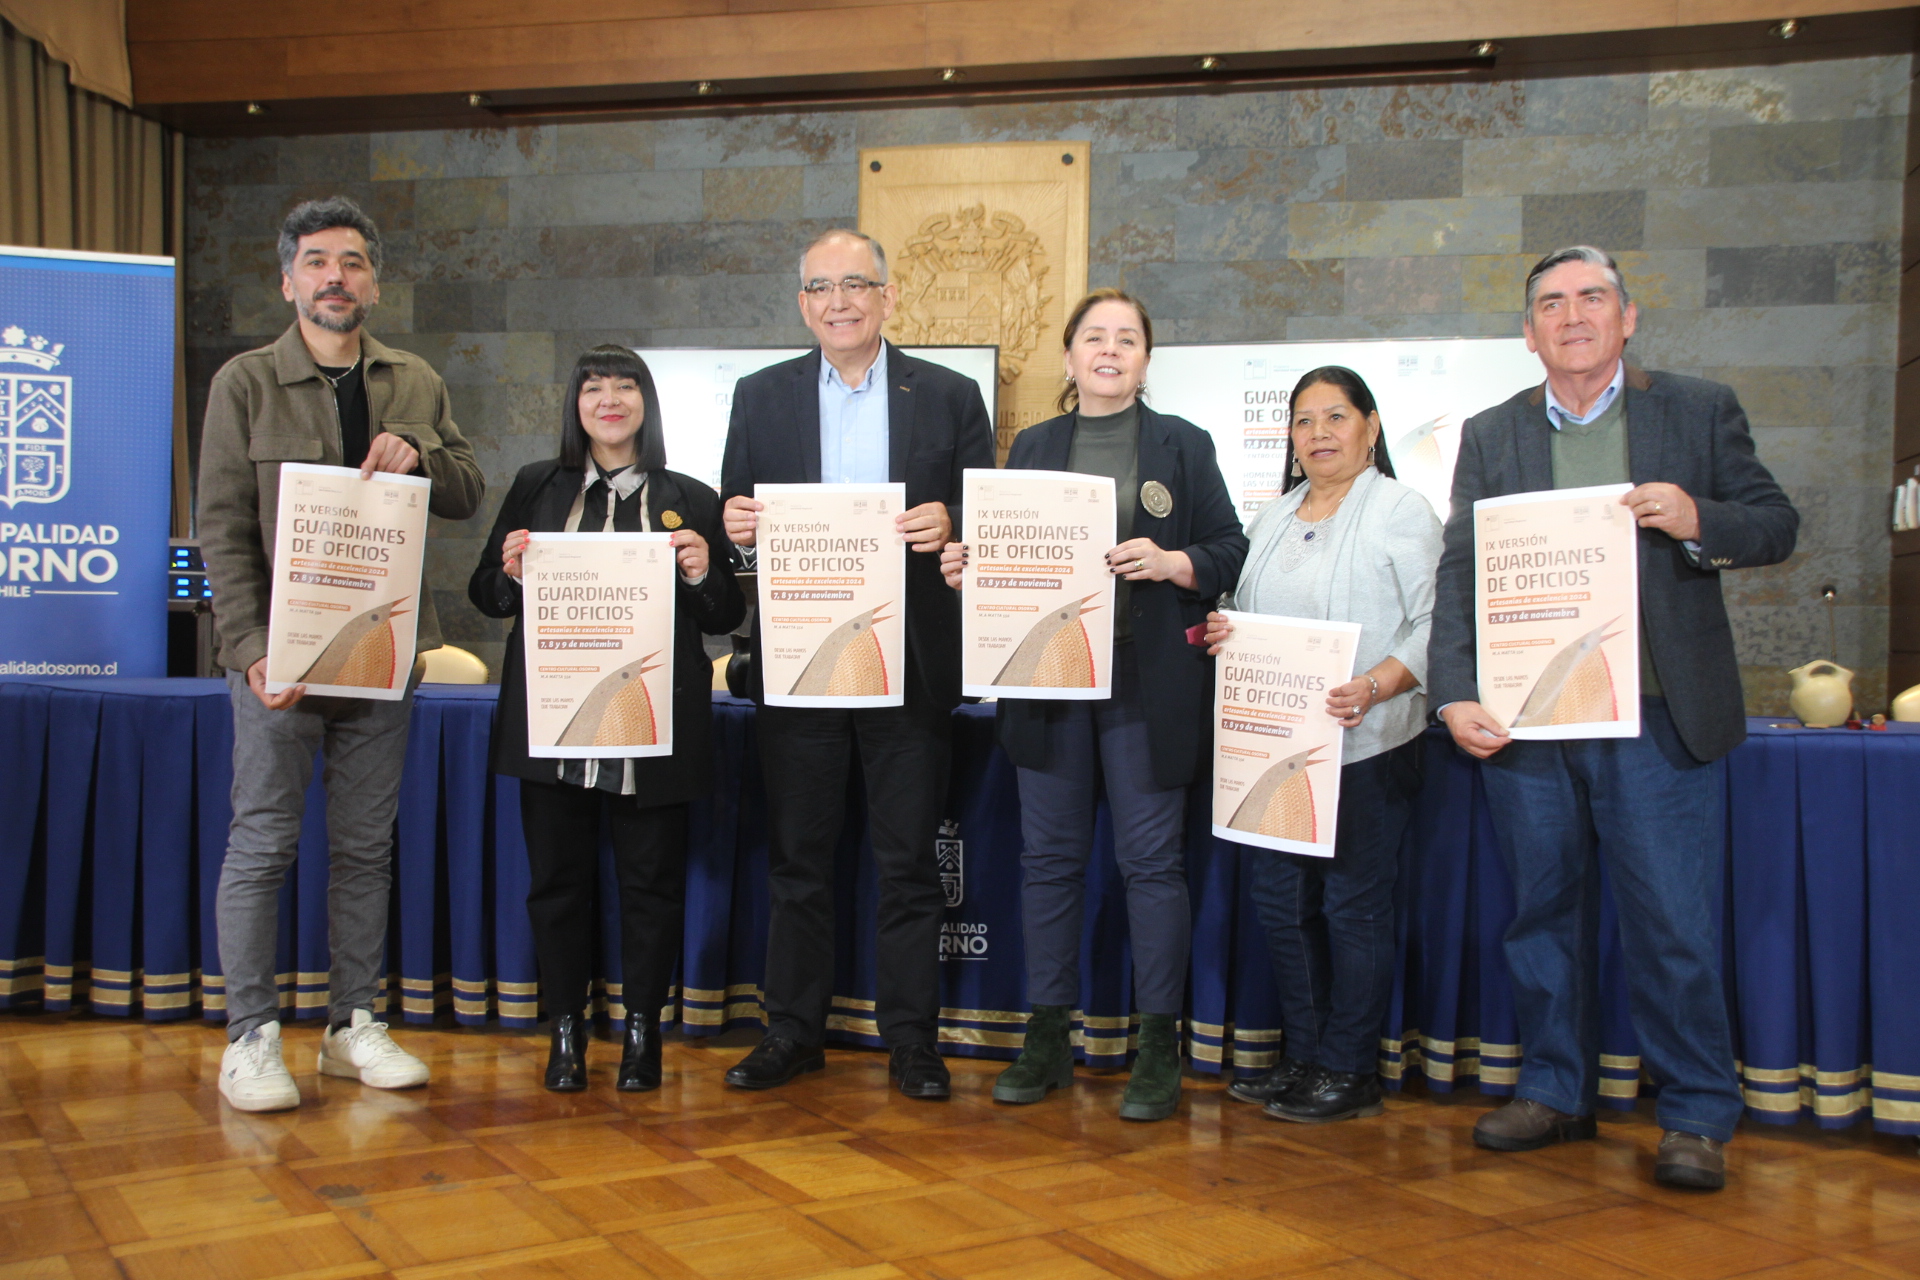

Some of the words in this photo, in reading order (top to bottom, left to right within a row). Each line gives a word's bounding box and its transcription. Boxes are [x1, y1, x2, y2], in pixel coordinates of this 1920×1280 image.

[1245, 409, 1264, 422] DE
[17, 489, 50, 498] AMORE
[294, 504, 305, 513] IX
[310, 504, 358, 518] VERSIÓN
[978, 510, 988, 519] IX
[992, 508, 1039, 519] VERSIÓN
[293, 519, 405, 544] GUARDIANES
[769, 524, 780, 532] IX
[784, 522, 830, 532] VERSIÓN
[978, 525, 1089, 540] GUARDIANES
[770, 538, 879, 552] GUARDIANES
[1486, 541, 1495, 551] IX
[1499, 534, 1547, 549] VERSIÓN
[292, 539, 315, 554] DE
[323, 541, 389, 562] OFICIOS
[978, 544, 999, 558] DE
[1007, 544, 1073, 560] OFICIOS
[0, 547, 119, 584] RNO
[771, 558, 791, 571] DE
[799, 558, 865, 572] OFICIOS
[1487, 547, 1605, 572] GUARDIANES
[337, 564, 367, 573] excelencia
[538, 572, 548, 581] IX
[552, 570, 599, 581] VERSIÓN
[322, 576, 331, 584] de
[333, 579, 372, 588] noviembre
[980, 579, 986, 587] 7,
[1018, 579, 1059, 587] noviembre
[1487, 576, 1507, 593] DE
[1516, 570, 1590, 590] OFICIOS
[538, 587, 648, 601] GUARDIANES
[774, 592, 780, 600] 7,
[538, 606, 559, 620] DE
[567, 606, 634, 620] OFICIOS
[1491, 615, 1497, 623] 7,
[1499, 614, 1505, 622] 8
[1506, 614, 1511, 622] y
[1512, 613, 1517, 621] 9
[1519, 612, 1528, 620] de
[1530, 609, 1575, 619] noviembre
[541, 641, 547, 649] 7,
[1226, 651, 1235, 660] IX
[1238, 653, 1280, 665] VERSIÓN
[1225, 666, 1325, 691] GUARDIANES
[1224, 686, 1240, 701] DE
[1247, 688, 1308, 709] OFICIOS
[1254, 725, 1289, 736] noviembre
